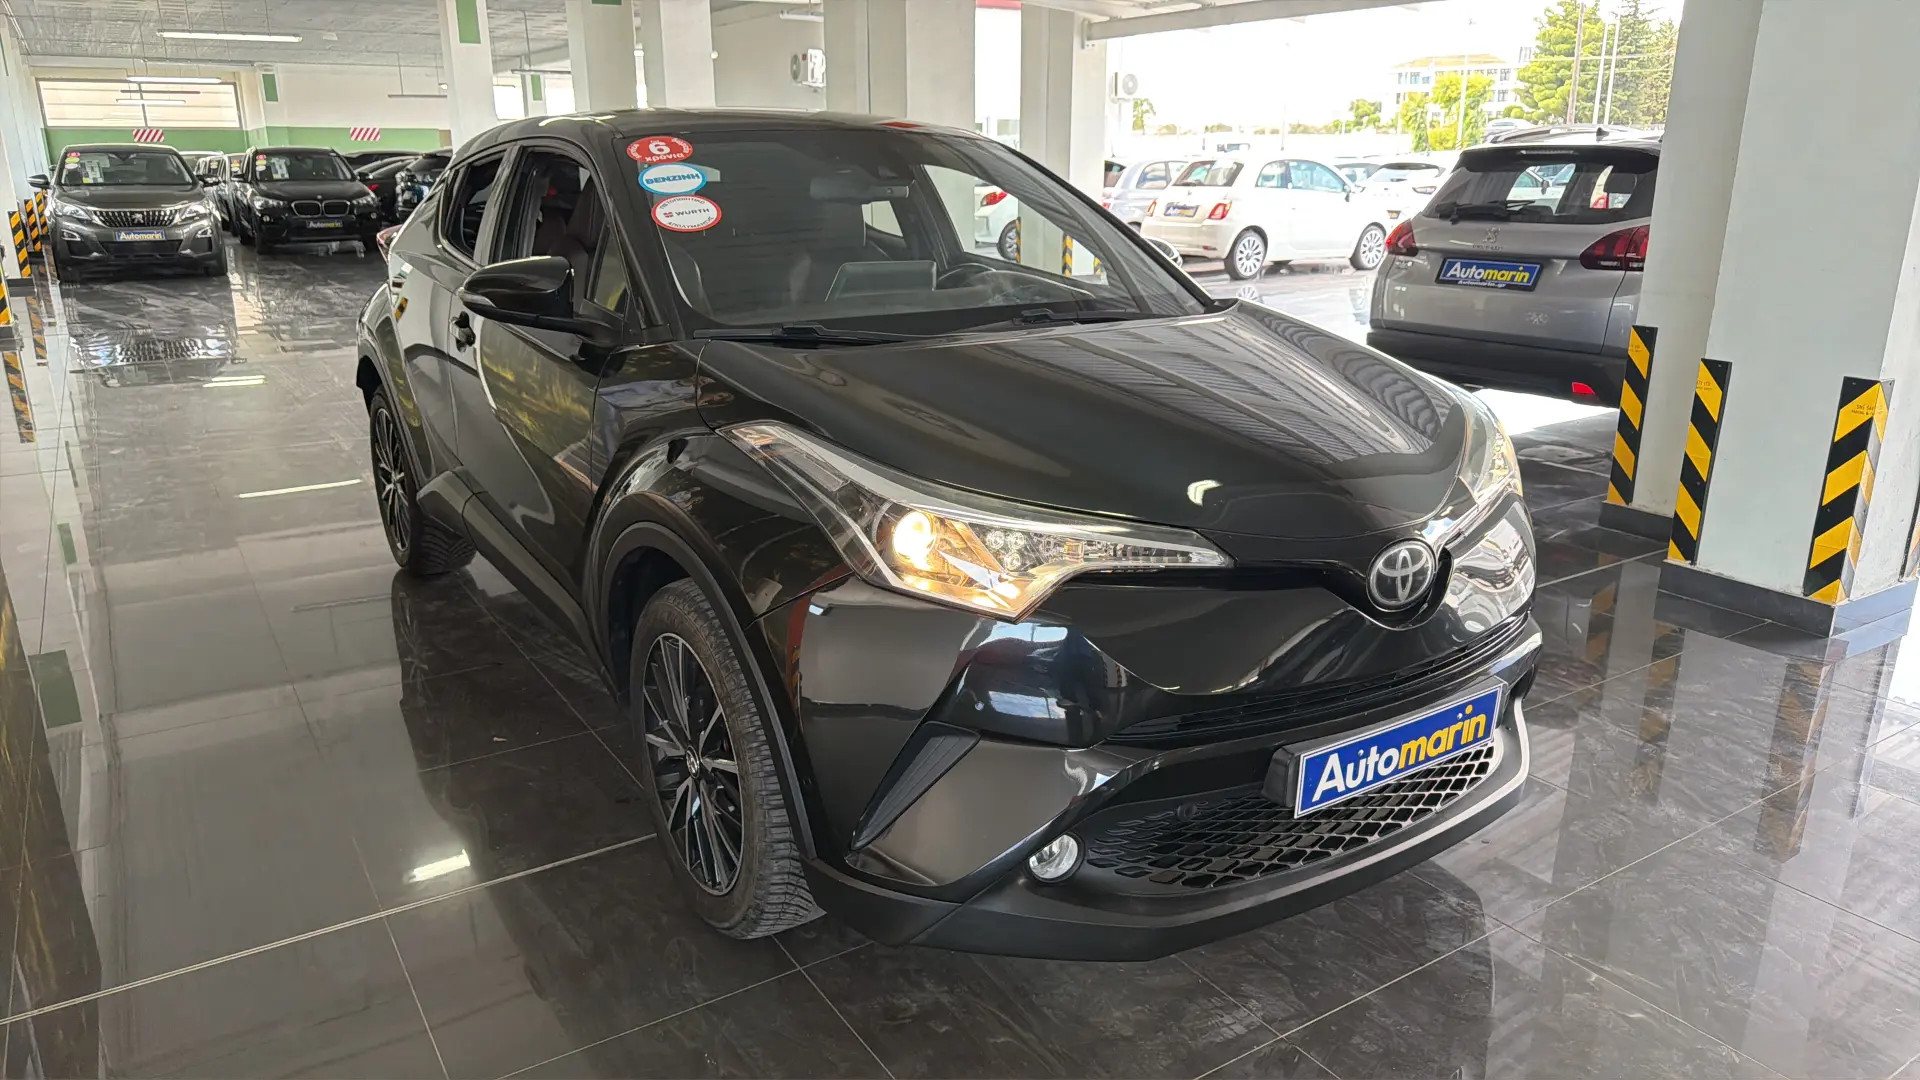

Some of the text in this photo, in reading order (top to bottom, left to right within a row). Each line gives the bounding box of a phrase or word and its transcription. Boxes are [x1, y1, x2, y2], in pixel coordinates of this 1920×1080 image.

[648, 141, 671, 155] 6
[120, 231, 162, 240] Automarin
[1446, 261, 1530, 283] Automarin
[1312, 704, 1488, 803] Automarin
